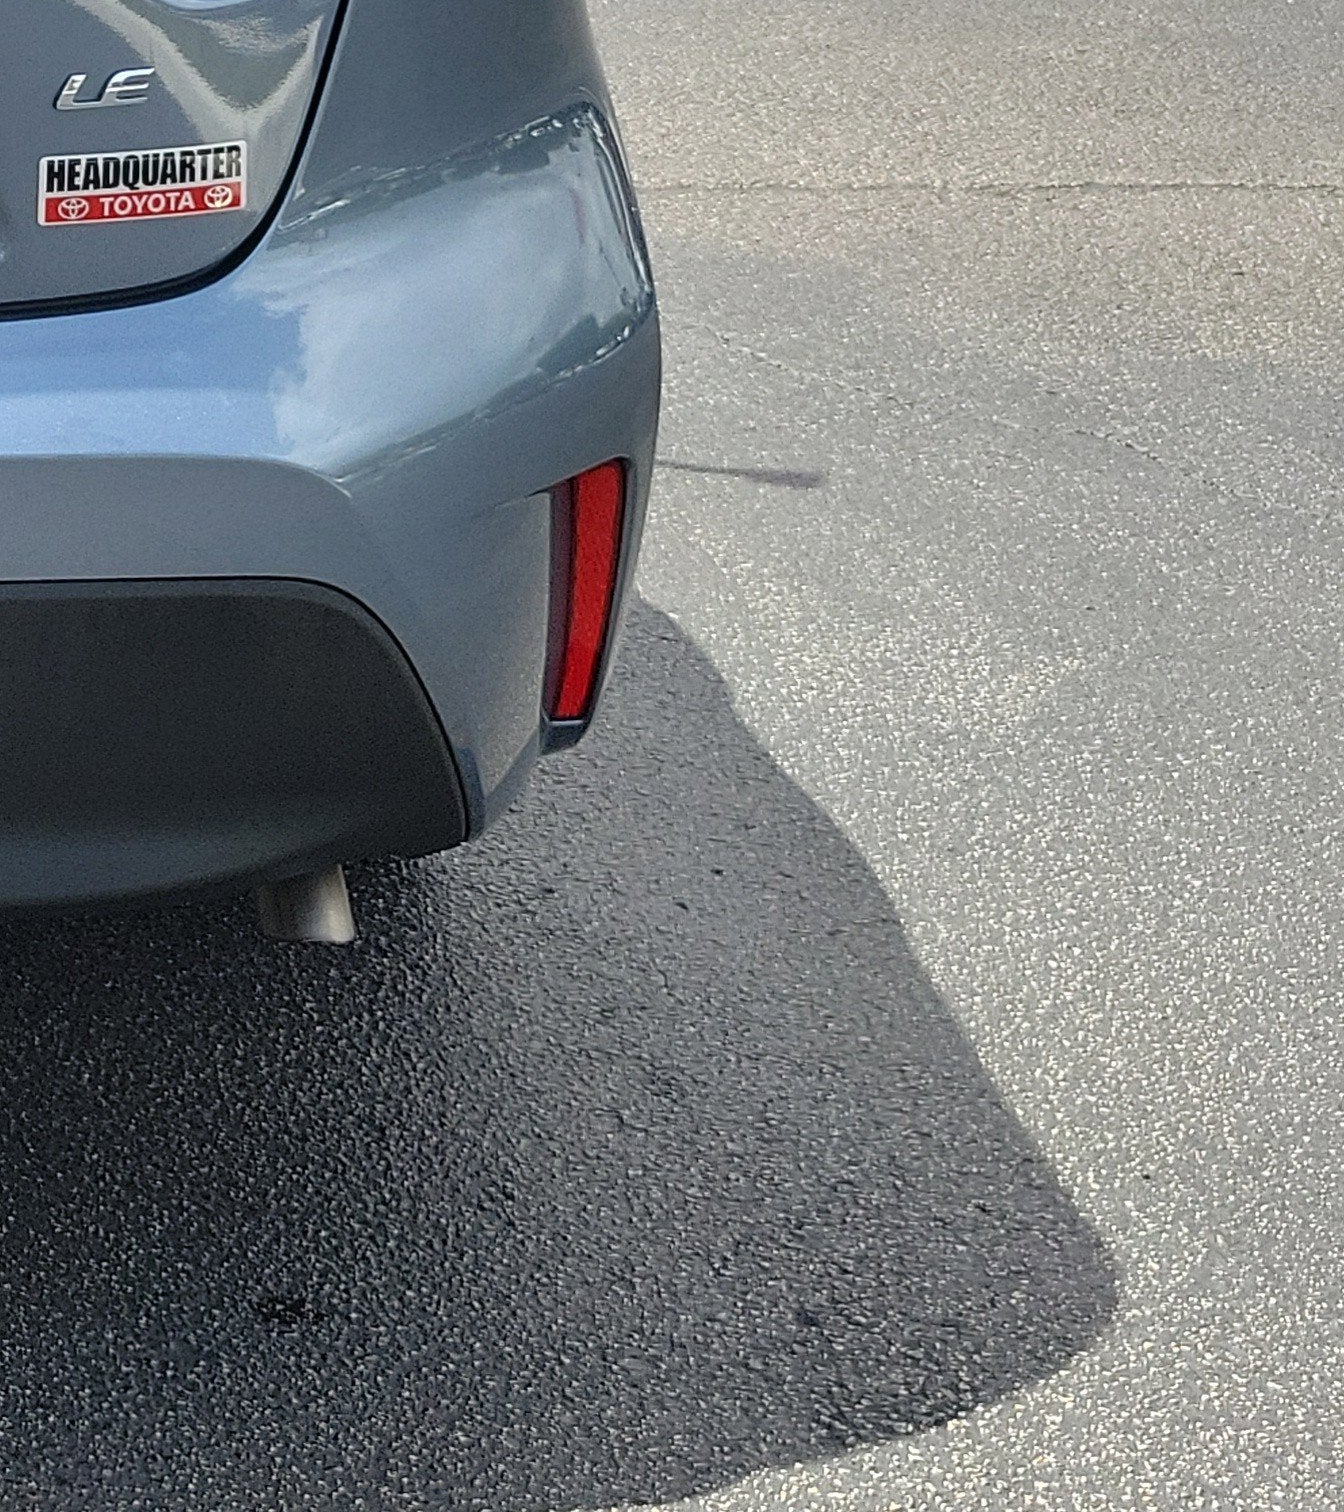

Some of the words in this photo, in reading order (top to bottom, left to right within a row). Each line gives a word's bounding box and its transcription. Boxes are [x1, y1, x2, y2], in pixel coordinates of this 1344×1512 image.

[53, 66, 156, 111] LE
[45, 144, 242, 193] HEADQUARTER
[99, 191, 196, 217] TOYOTA
